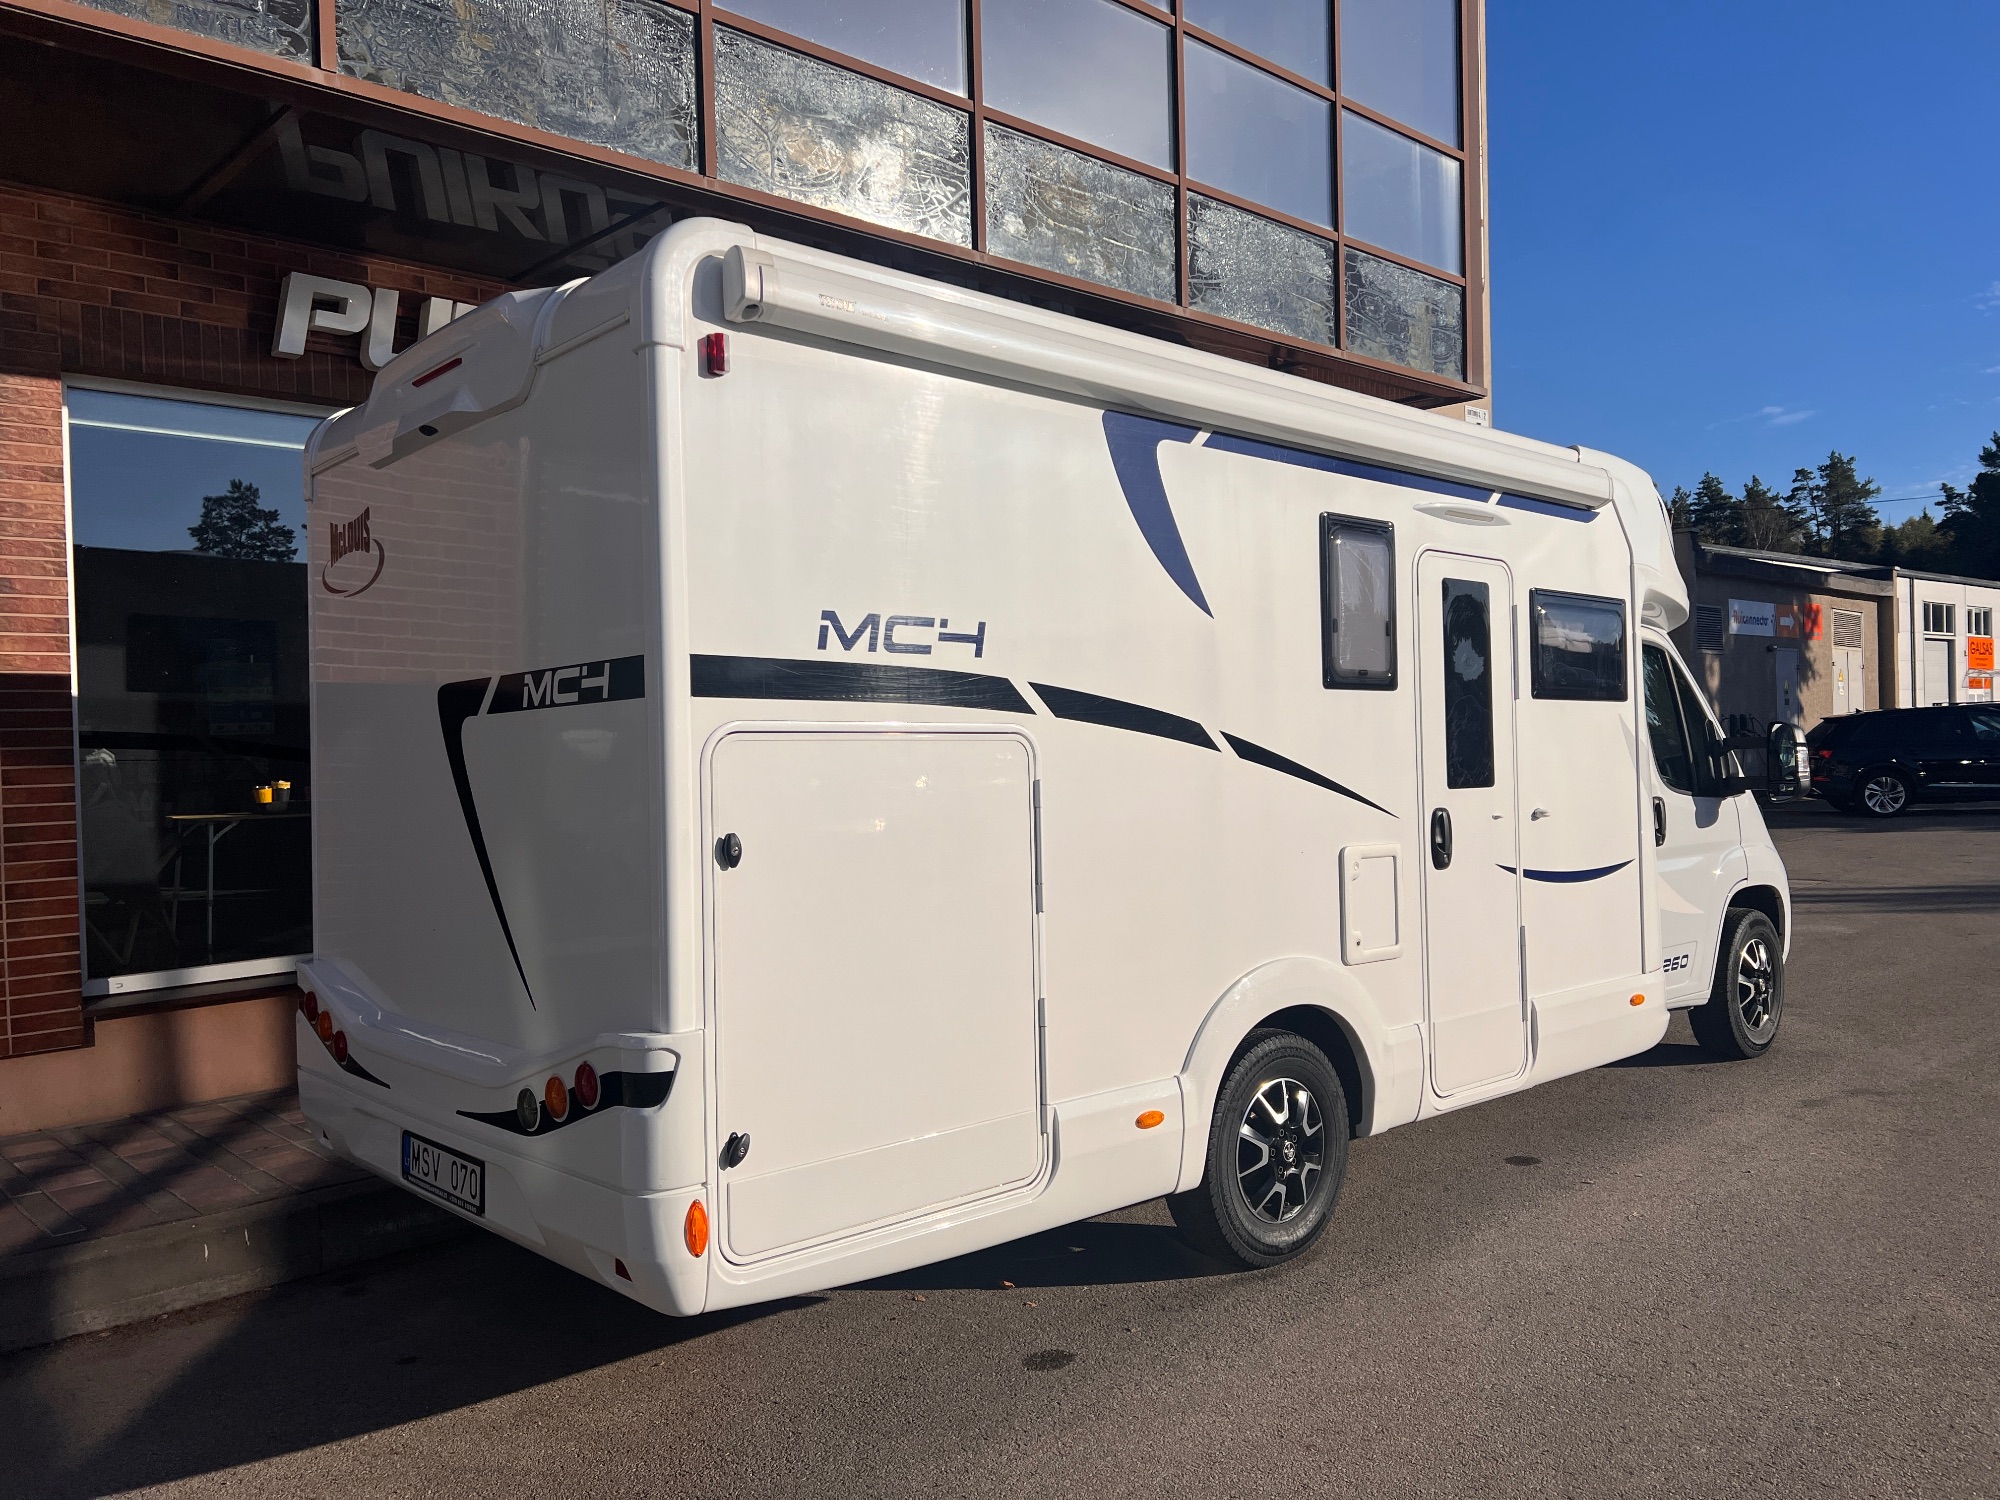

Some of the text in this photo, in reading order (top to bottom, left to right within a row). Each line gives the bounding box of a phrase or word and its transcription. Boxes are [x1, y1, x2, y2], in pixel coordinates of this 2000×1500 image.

[817, 609, 986, 658] MC4
[1970, 641, 1993, 656] GALSAS
[522, 662, 610, 708] MC4
[1663, 954, 1689, 973] 260
[411, 1141, 441, 1183] MSV
[450, 1160, 478, 1200] 070
